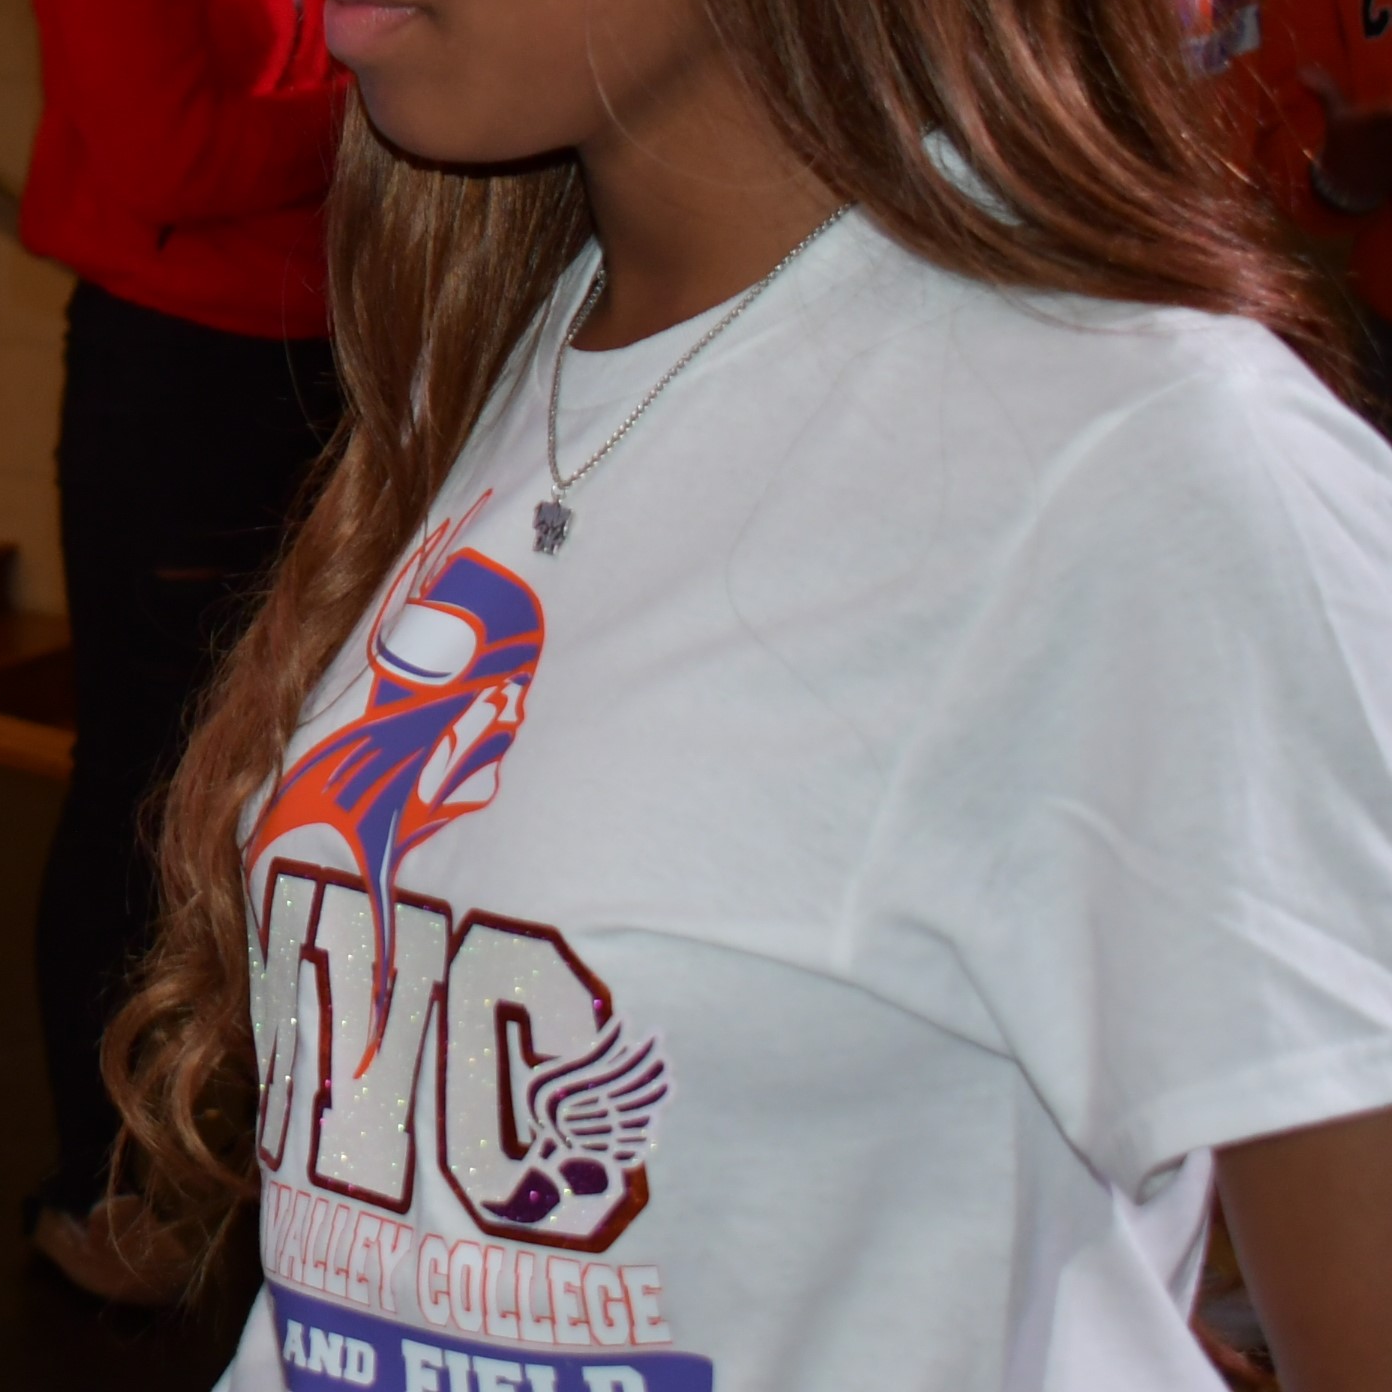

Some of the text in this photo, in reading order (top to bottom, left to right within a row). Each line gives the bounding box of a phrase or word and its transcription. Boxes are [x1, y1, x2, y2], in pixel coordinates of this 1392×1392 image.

[264, 1180, 674, 1347] VALLEY COLLEGE
[282, 1318, 376, 1386] AND
